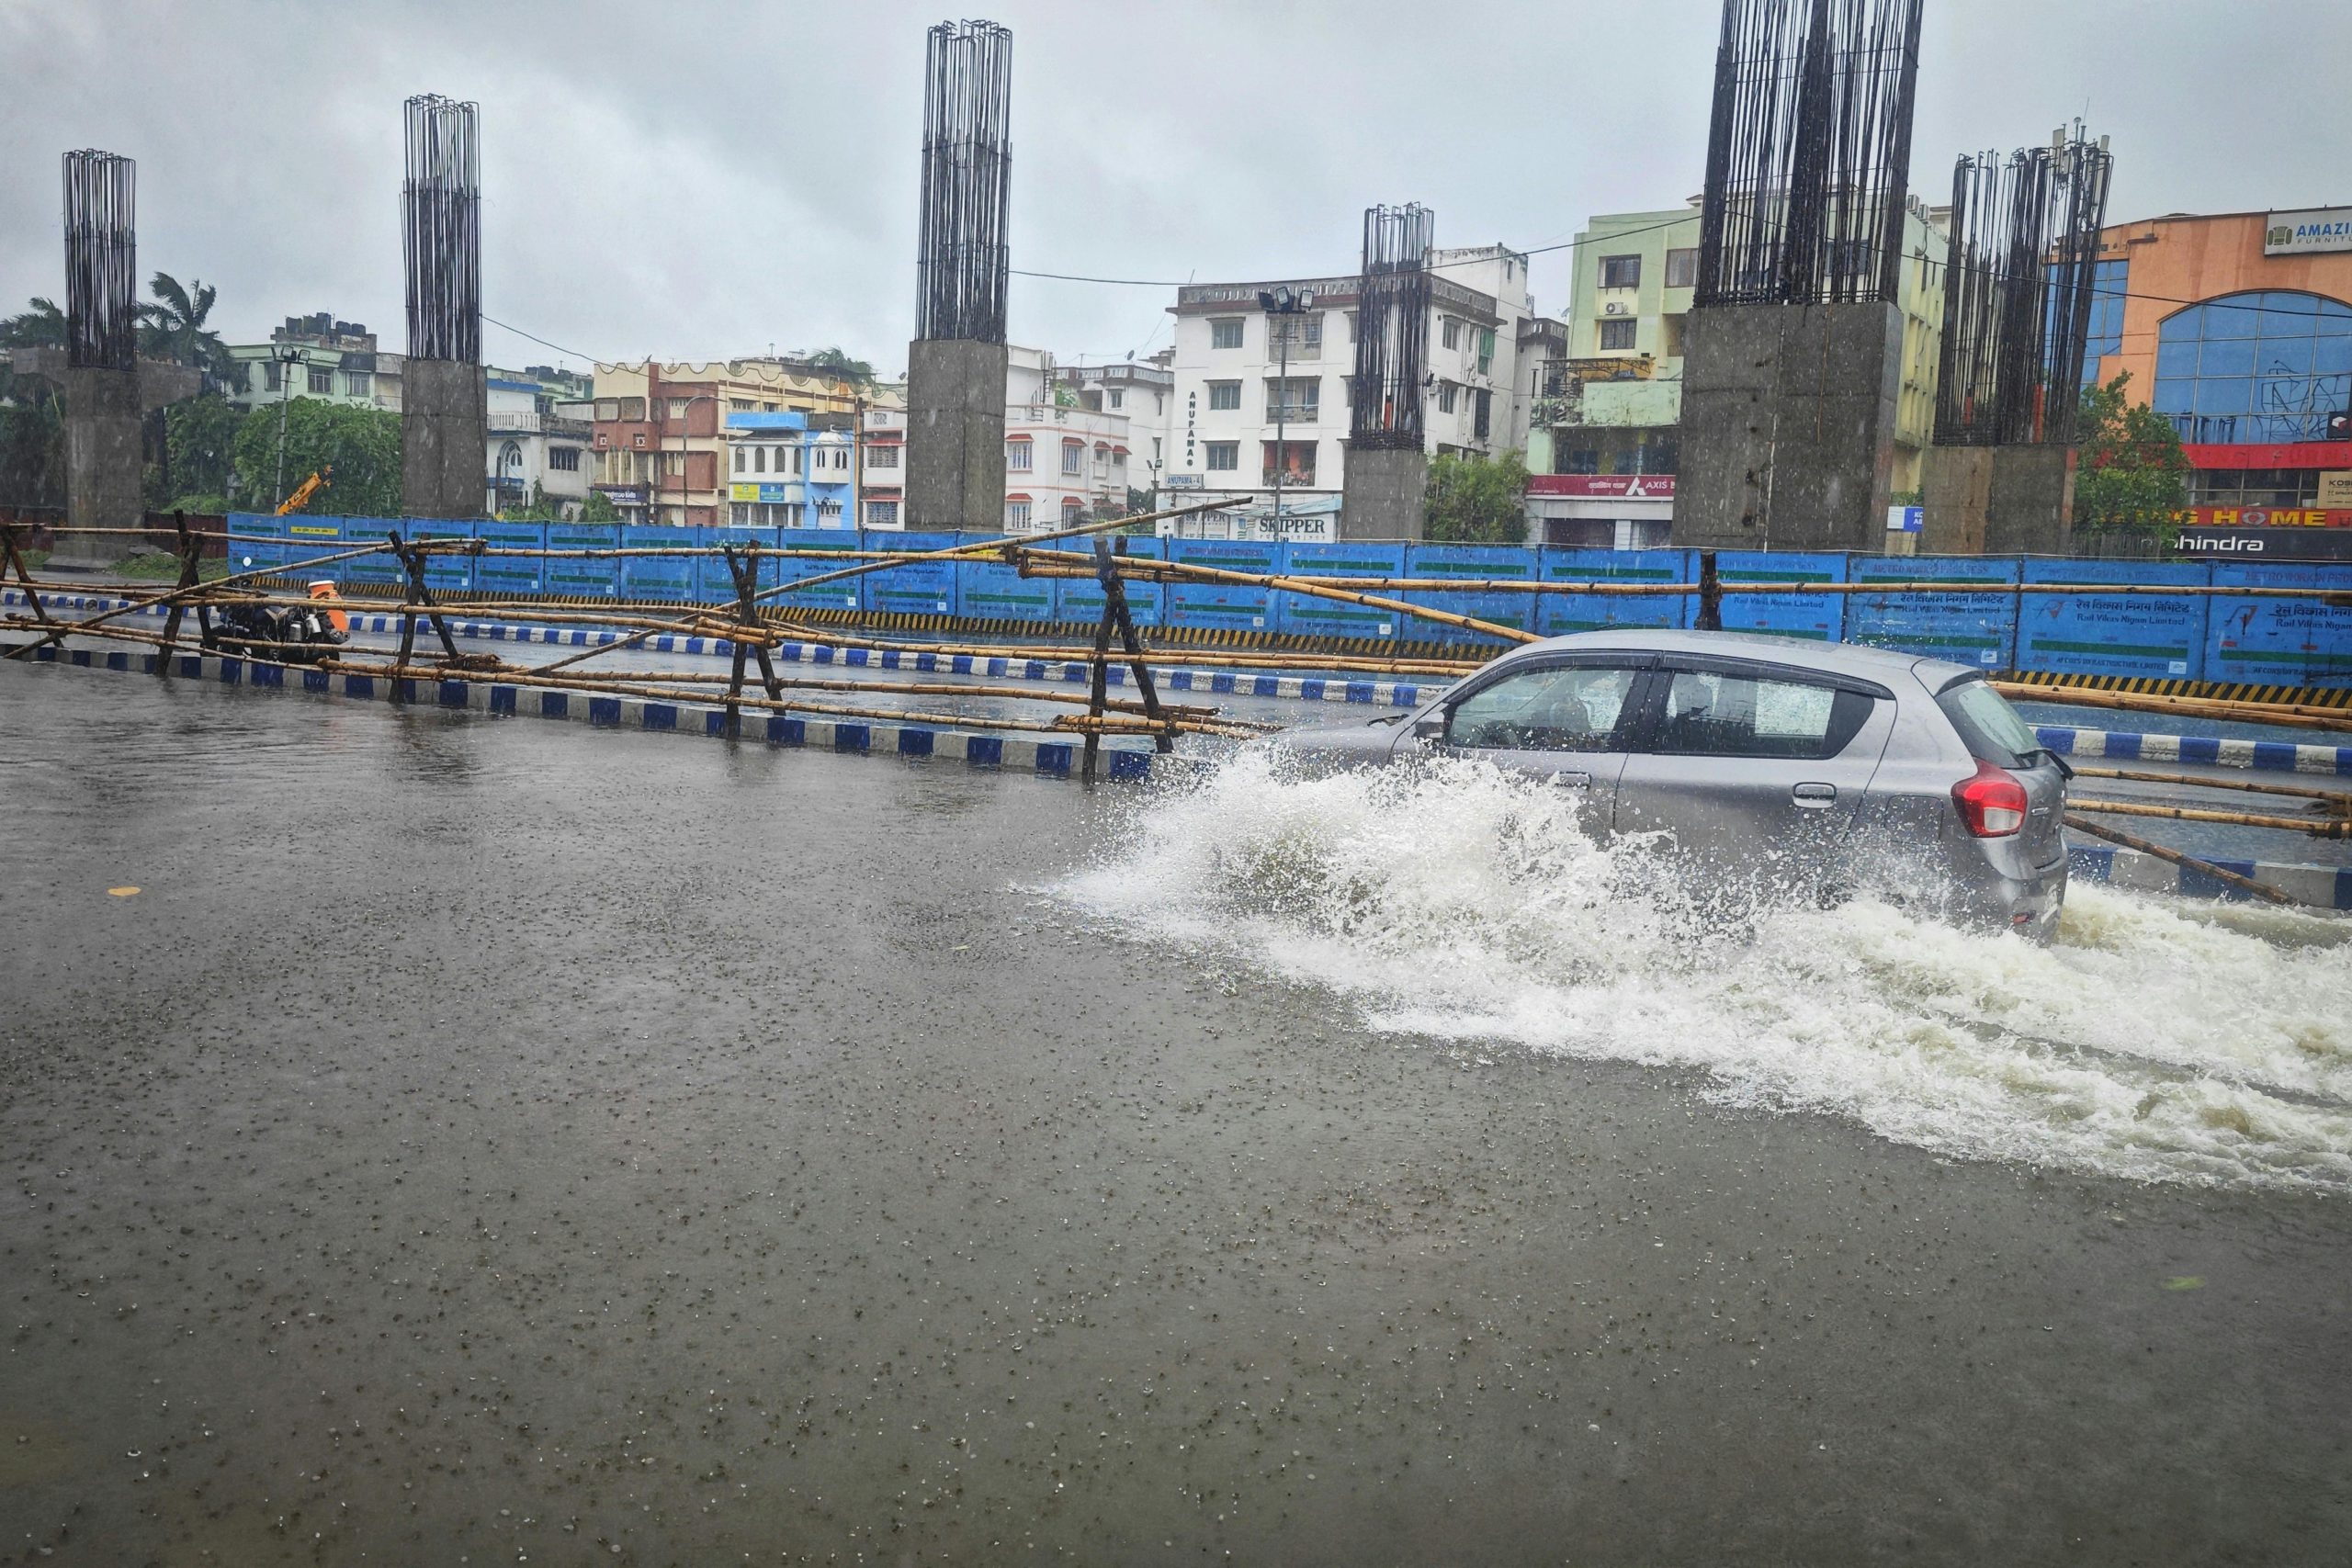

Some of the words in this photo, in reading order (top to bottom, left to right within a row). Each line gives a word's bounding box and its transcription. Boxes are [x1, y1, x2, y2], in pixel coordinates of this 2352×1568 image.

[2296, 222, 2352, 236] AMAZI
[1187, 391, 1196, 457] ANUPAMA
[1168, 476, 1193, 484] ANUPAMA
[1645, 480, 1668, 490] AXIS
[1186, 513, 1226, 523] SKPER
[2213, 510, 2327, 527] HOME
[1260, 517, 1325, 534] SKIPPER
[2166, 536, 2264, 551] hindra
[2245, 571, 2283, 581] METRO
[2285, 572, 2314, 582] WORK
[2076, 598, 2090, 610] रेल
[2092, 598, 2123, 611] विकास
[2275, 604, 2291, 616] रेल
[2293, 604, 2328, 617] विकास
[2149, 616, 2186, 626] Limited
[2276, 618, 2295, 627] Rail
